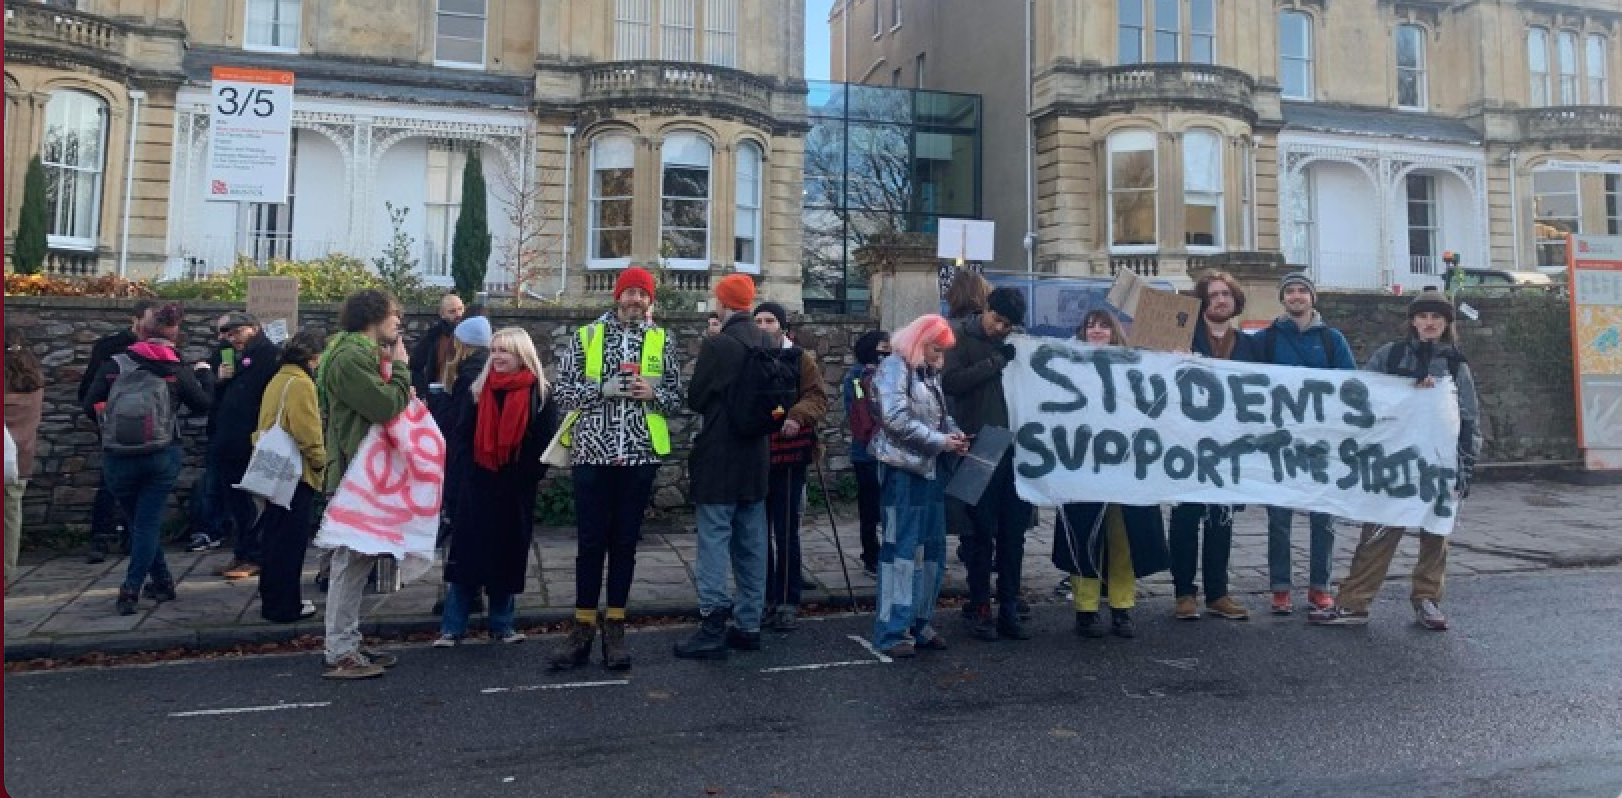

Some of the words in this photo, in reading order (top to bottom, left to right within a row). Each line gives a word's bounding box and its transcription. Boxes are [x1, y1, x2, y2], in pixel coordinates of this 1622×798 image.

[217, 87, 275, 118] 3/5
[1029, 344, 1377, 429] STUDENTS
[1016, 421, 1257, 489] SUPPORT
[1254, 429, 1330, 485] THE
[1335, 437, 1455, 518] STRIKE
